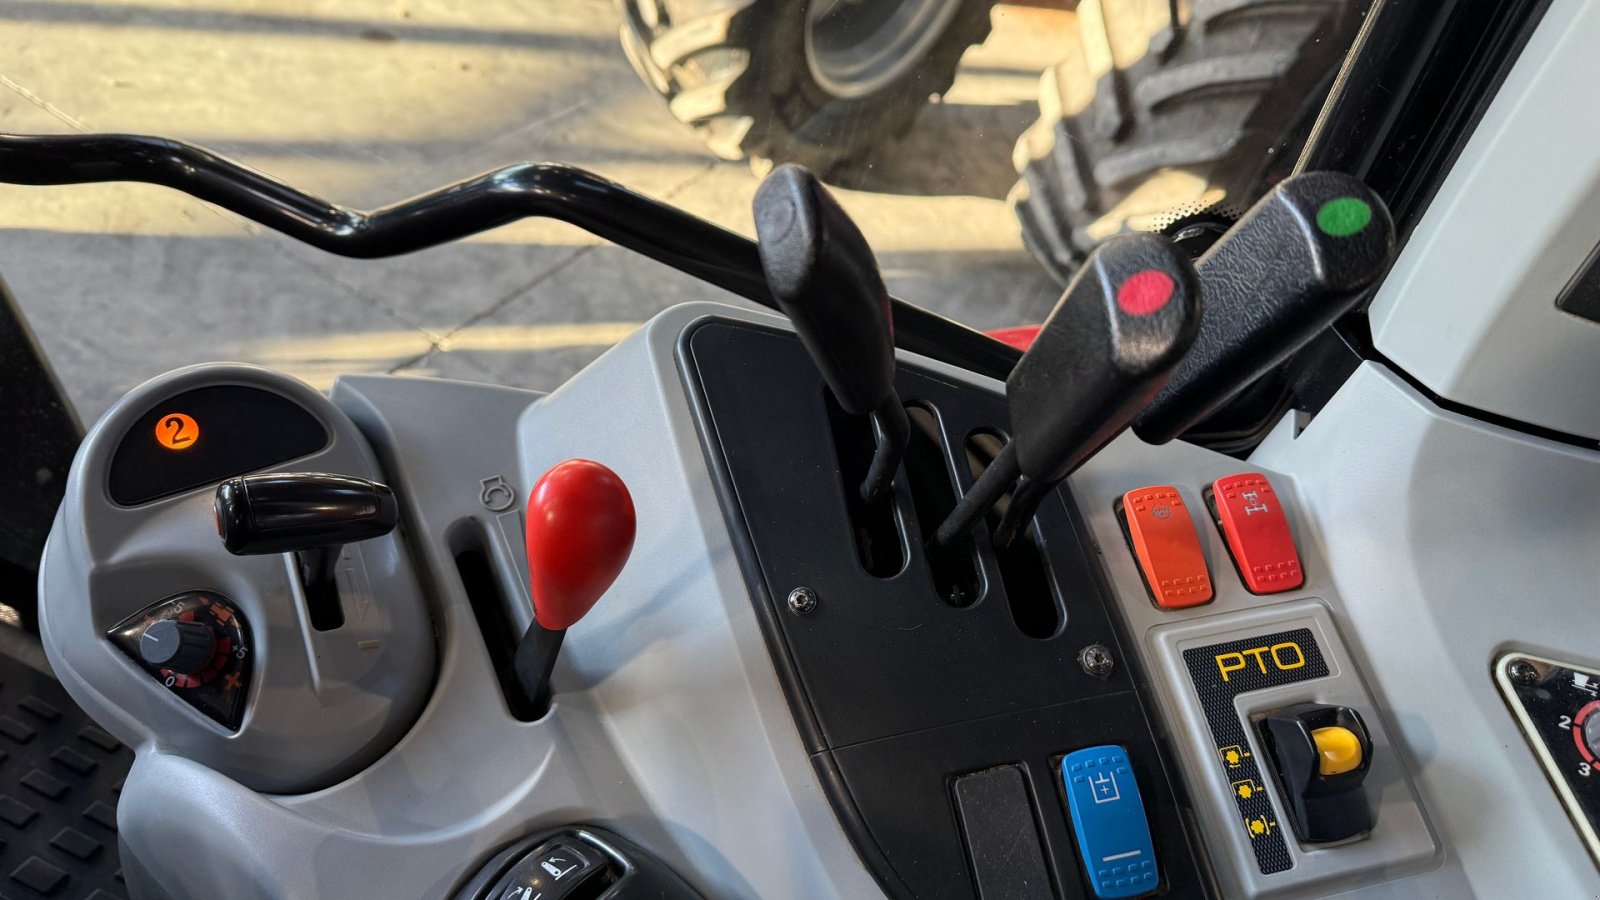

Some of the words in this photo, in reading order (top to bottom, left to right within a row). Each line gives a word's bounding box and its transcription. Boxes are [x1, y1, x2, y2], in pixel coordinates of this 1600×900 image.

[165, 417, 191, 445] 2
[1215, 642, 1306, 682] PTO
[165, 676, 175, 687] 0
[1558, 715, 1571, 730] 2
[1578, 762, 1591, 776] 3
